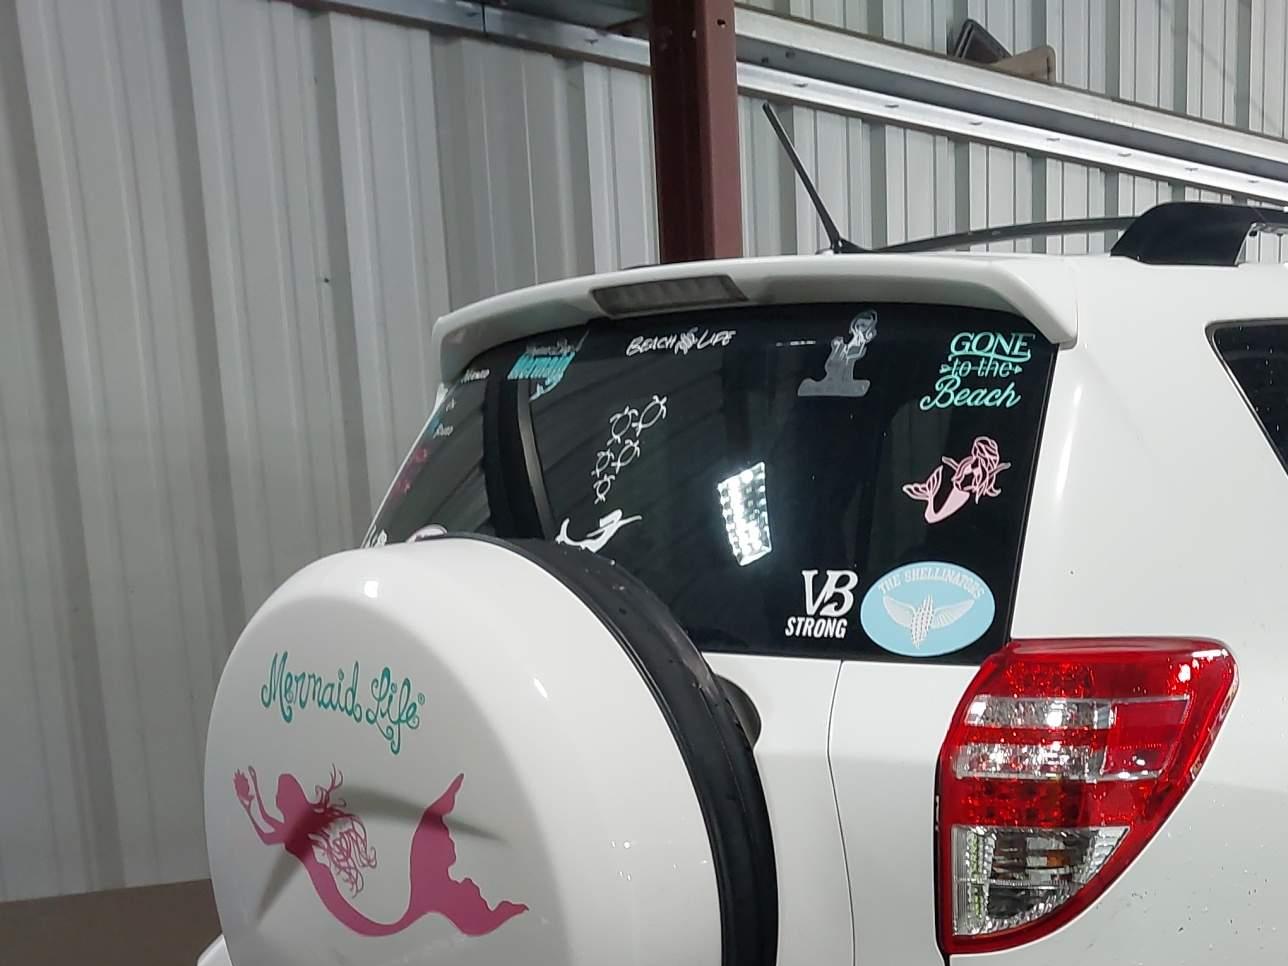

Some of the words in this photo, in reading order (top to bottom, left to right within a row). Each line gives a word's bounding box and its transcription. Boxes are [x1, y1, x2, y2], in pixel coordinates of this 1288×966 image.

[627, 334, 676, 356] BEACH
[698, 330, 736, 349] LIFE
[949, 331, 1035, 359] GONE
[951, 357, 972, 377] to
[977, 357, 1012, 377] the
[920, 374, 1021, 410] Beach
[801, 569, 858, 617] VB
[785, 616, 848, 638] STRONG
[261, 651, 362, 723] Mermaid
